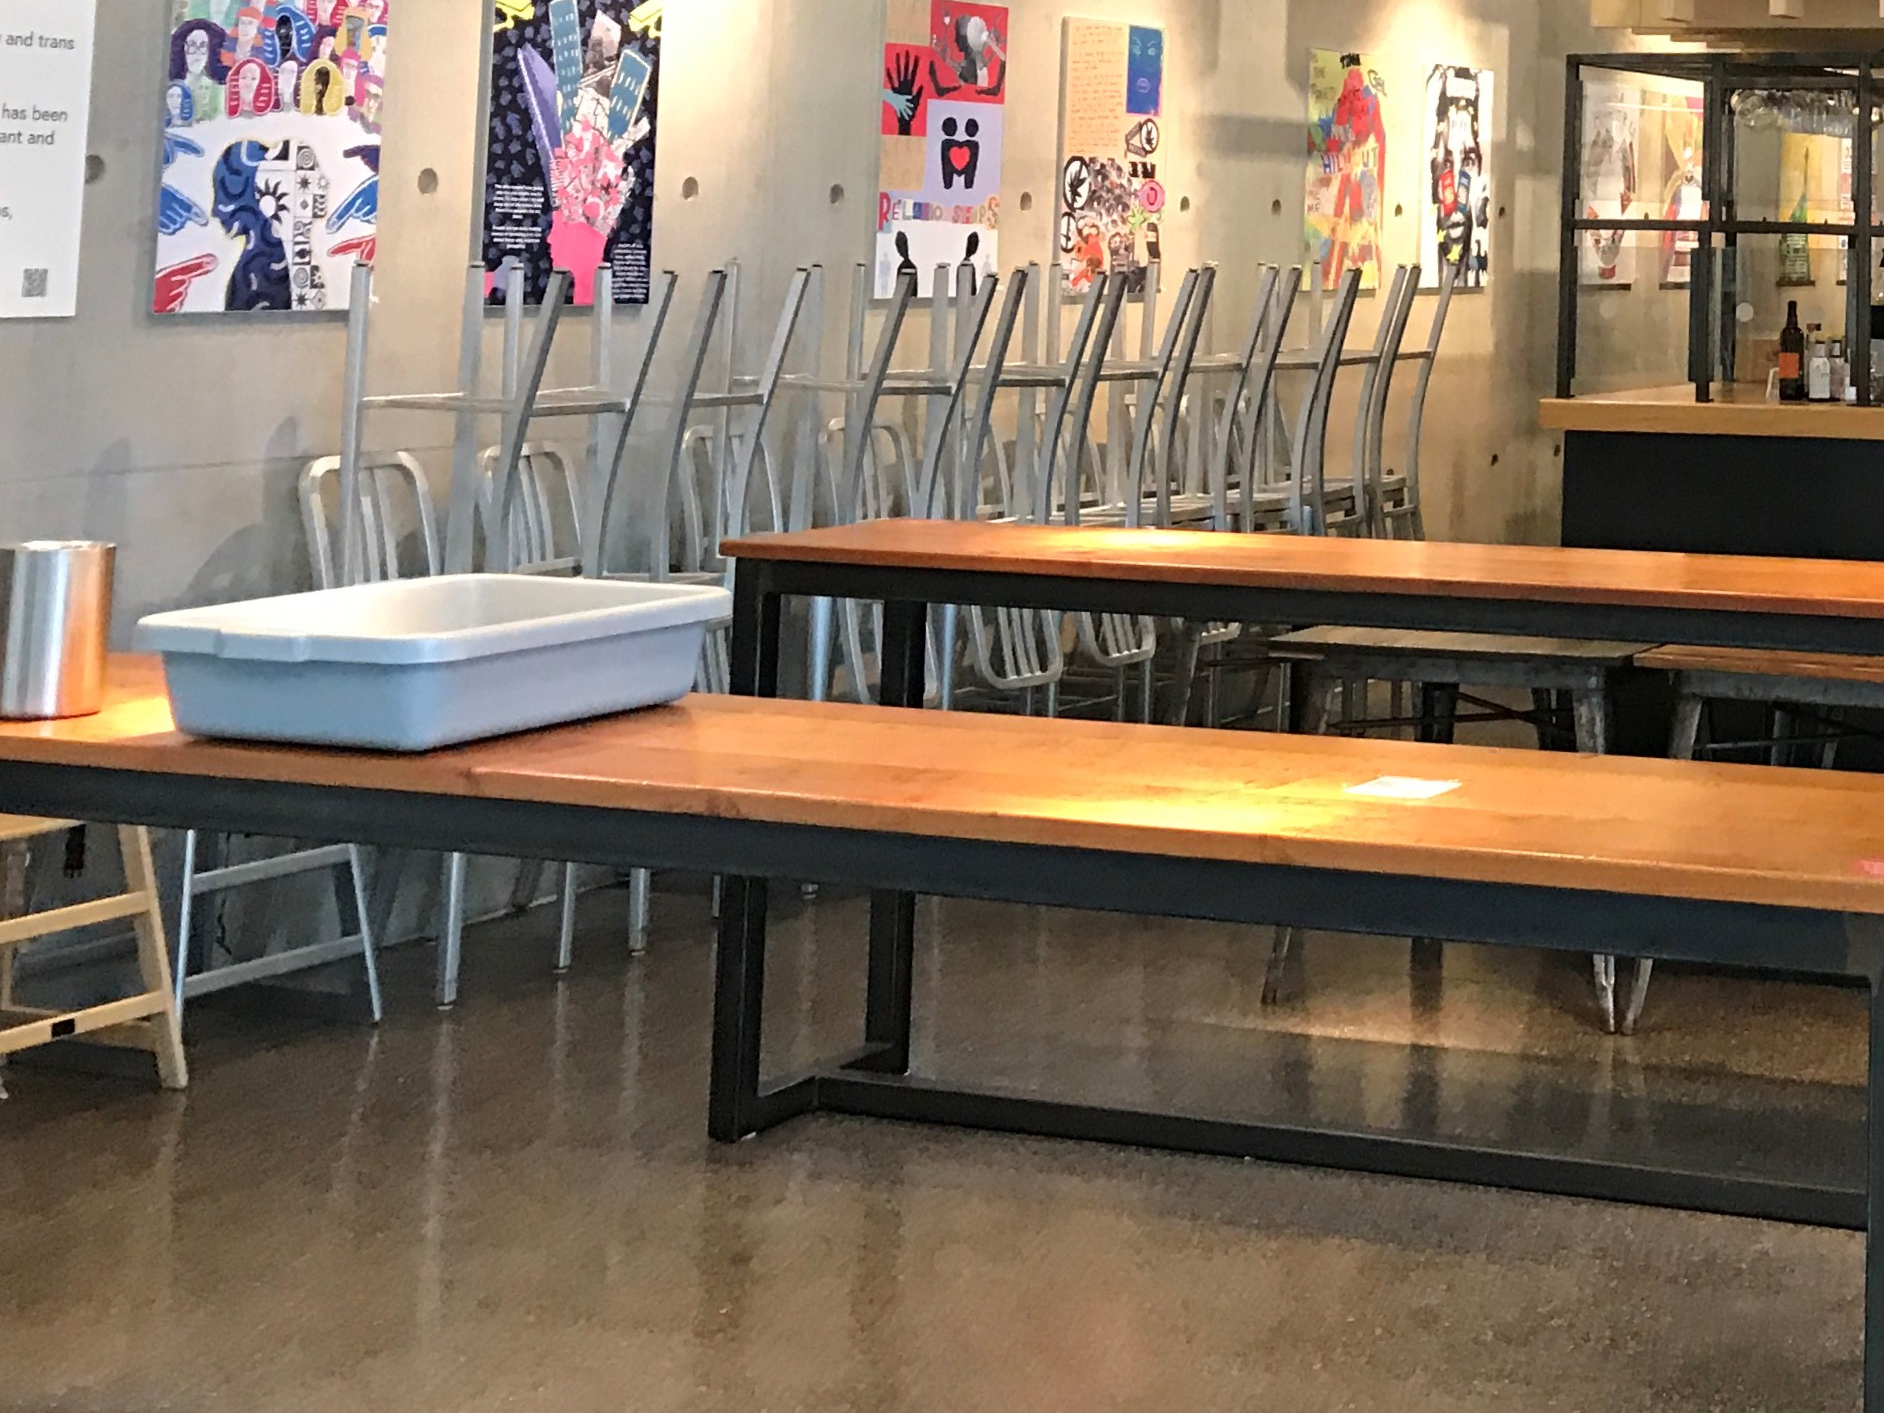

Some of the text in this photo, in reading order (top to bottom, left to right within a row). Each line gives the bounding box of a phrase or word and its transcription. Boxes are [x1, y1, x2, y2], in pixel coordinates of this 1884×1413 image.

[5, 30, 75, 50] and trans
[2, 102, 68, 122] has been
[27, 130, 55, 145] and
